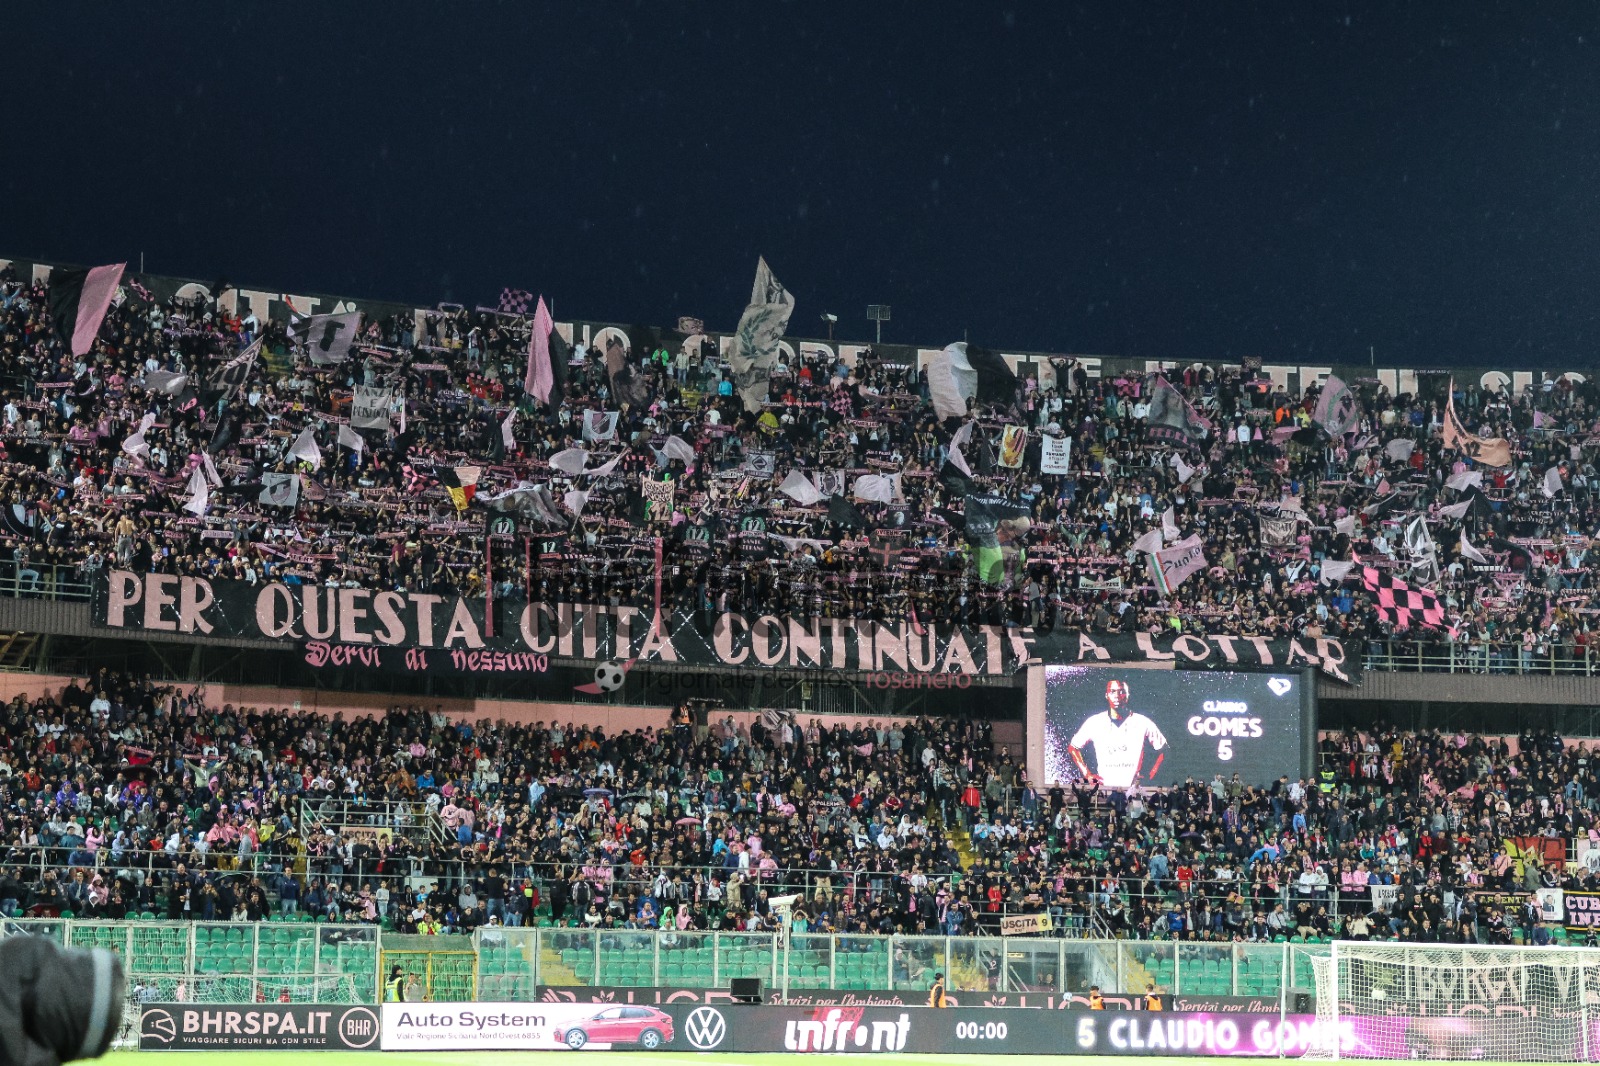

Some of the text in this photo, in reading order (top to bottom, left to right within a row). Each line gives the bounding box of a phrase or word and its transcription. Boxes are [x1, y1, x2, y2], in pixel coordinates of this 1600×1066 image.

[497, 522, 510, 534] 12
[748, 519, 761, 531] 12
[541, 542, 556, 553] 12
[107, 569, 215, 634] PER
[255, 582, 486, 649] QUESTA
[520, 601, 678, 661] CITTA
[713, 611, 1043, 675] CONTINUATE
[1078, 632, 1112, 661] A
[1135, 631, 1349, 682] LOTTAR
[405, 648, 428, 671] di
[451, 650, 548, 673] nessuno
[1203, 700, 1248, 713] CLAUDIO
[1187, 716, 1263, 738] GOMES
[1217, 739, 1233, 761] 5
[1002, 918, 1048, 929] USCITA 9
[183, 1010, 332, 1035] BHRSPA.IT
[347, 1019, 371, 1036] BHR
[397, 1012, 546, 1031] Auto System
[785, 1009, 911, 1051] infront
[417, 1032, 445, 1041] Regione
[479, 1032, 499, 1040] Nord
[521, 1032, 541, 1040] 6855
[956, 1022, 1008, 1040] 00:00
[1077, 1019, 1096, 1047] 5
[1108, 1019, 1241, 1050] CLAUDIO
